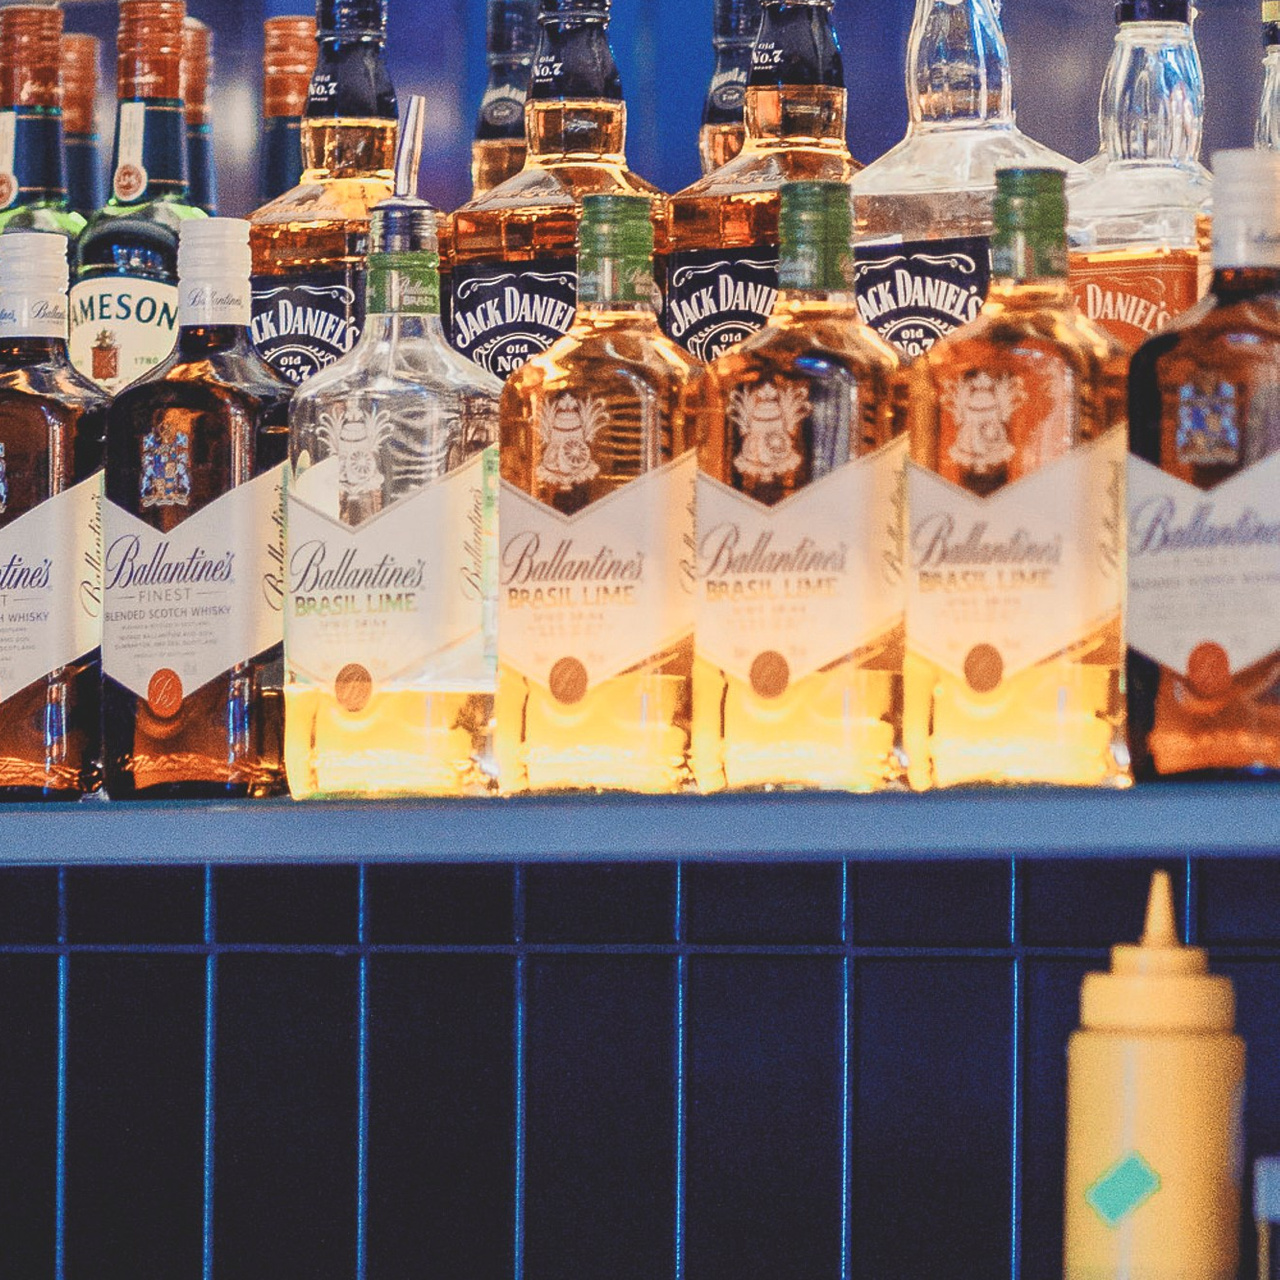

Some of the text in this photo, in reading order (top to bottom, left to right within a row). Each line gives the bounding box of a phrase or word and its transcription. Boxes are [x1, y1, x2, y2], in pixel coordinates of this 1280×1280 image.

[857, 269, 984, 325] ACK DANIEL'S
[71, 293, 179, 331] AMESON
[455, 286, 577, 349] JACK DANIEL
[670, 285, 719, 338] JACK
[251, 299, 360, 353] CK DANIEL'S
[720, 333, 742, 343] Old
[901, 328, 924, 340] Old
[280, 355, 302, 366] Old
[506, 344, 529, 354] Old
[280, 365, 312, 382] o.7
[104, 534, 236, 591] Ballantine's
[501, 530, 645, 586] Ballantine's
[698, 523, 849, 578] Ballantine's
[289, 539, 427, 594] Ballantine's
[138, 588, 191, 602] FINEST
[507, 585, 636, 611] BRASIL LIME
[706, 576, 842, 602] BRASIL LIME
[8, 611, 50, 623] WHISKY
[105, 605, 232, 622] BLENDED SCOTCH WHISKY
[294, 592, 419, 618] BRASIL LIME
